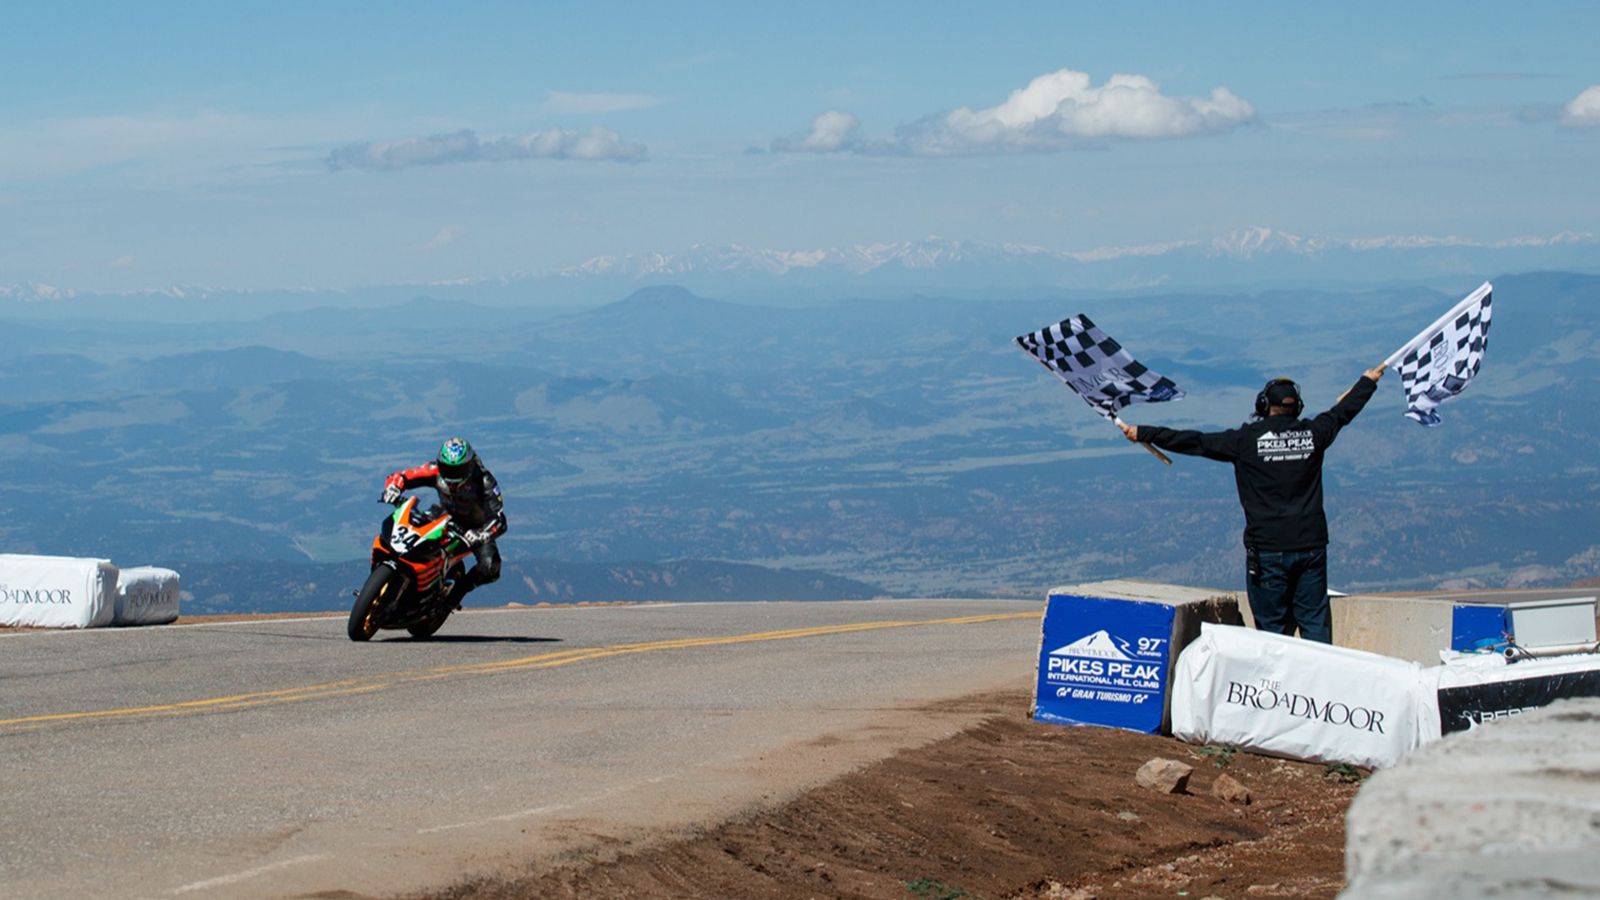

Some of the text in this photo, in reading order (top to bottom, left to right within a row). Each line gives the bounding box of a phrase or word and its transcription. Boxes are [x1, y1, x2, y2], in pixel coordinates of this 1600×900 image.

[1257, 437, 1313, 448] PIKES PEAK
[391, 526, 421, 549] 34
[1048, 657, 1160, 680] PIKES PEAK
[1047, 672, 1160, 688] INTERNATIONAL HILL CLIMB
[1260, 679, 1280, 690] THE
[1072, 689, 1095, 699] GRAN
[1096, 691, 1131, 703] TURISMO
[1226, 680, 1386, 734] BROADMOOR
